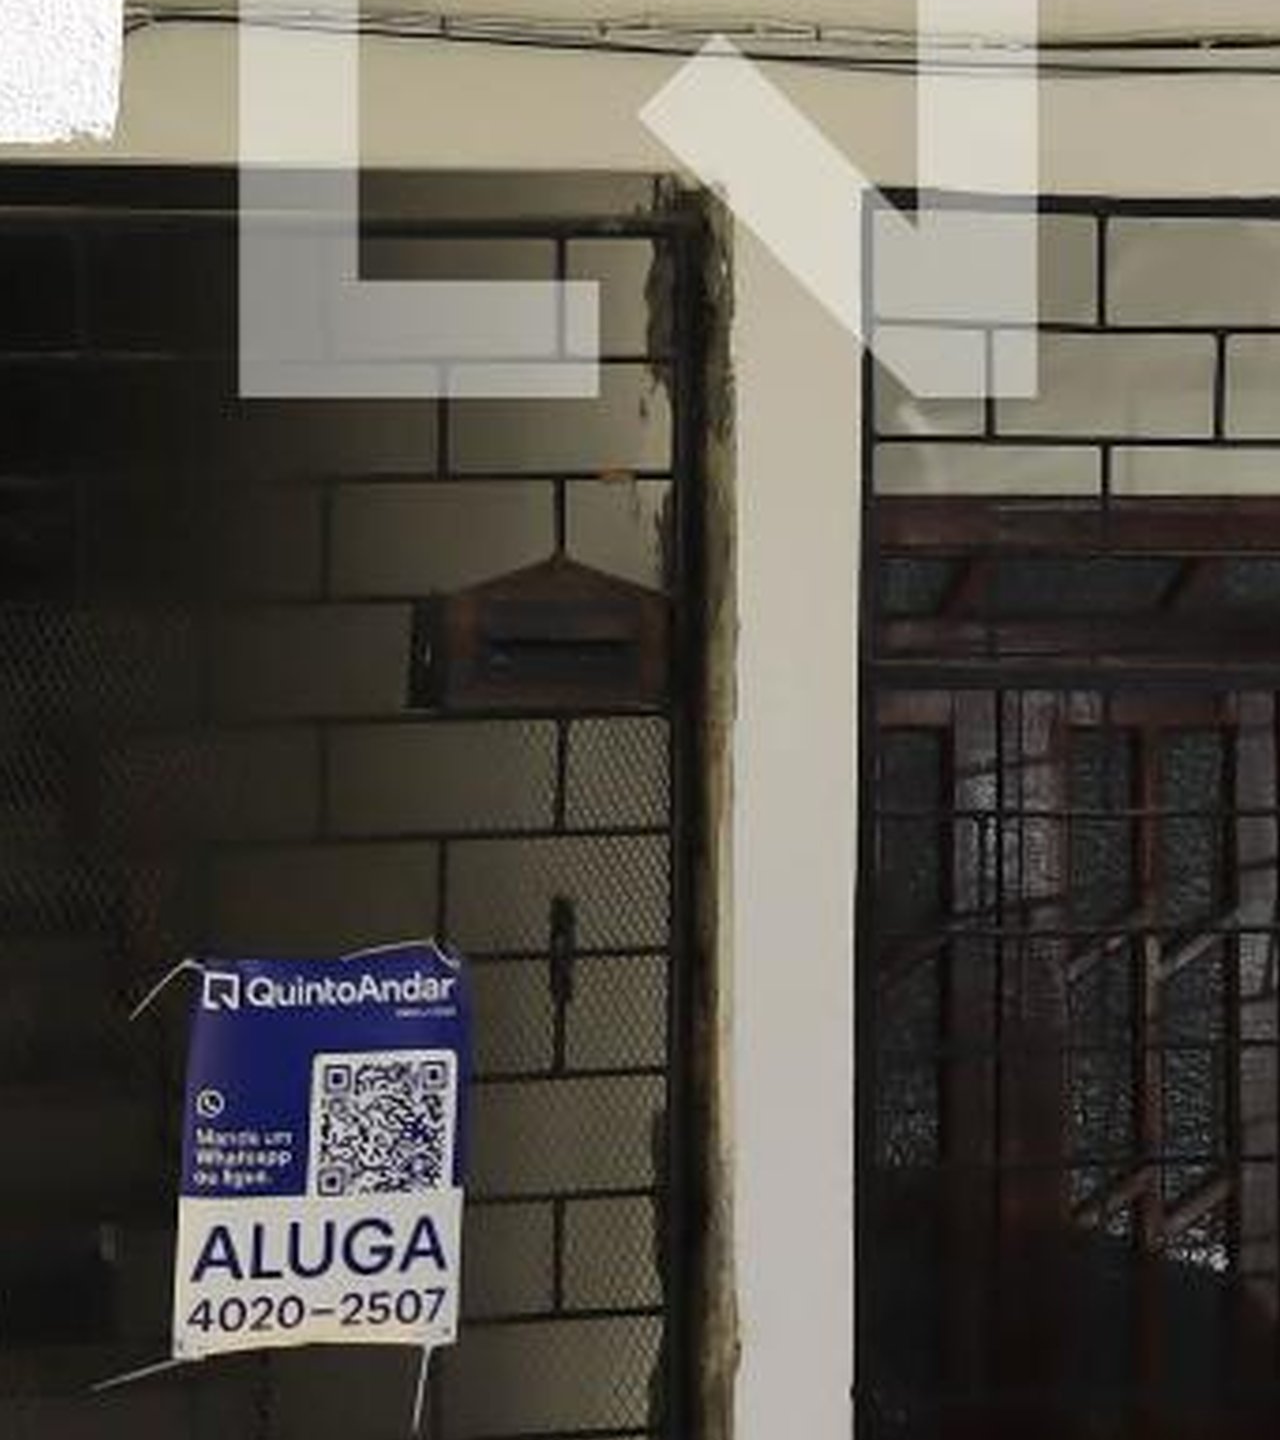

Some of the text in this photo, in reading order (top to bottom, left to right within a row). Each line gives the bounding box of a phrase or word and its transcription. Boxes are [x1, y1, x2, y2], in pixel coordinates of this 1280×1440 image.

[246, 972, 455, 1007] QuintoAndar
[190, 1215, 447, 1282] ALUGA
[187, 1286, 447, 1332] 4020-2507
